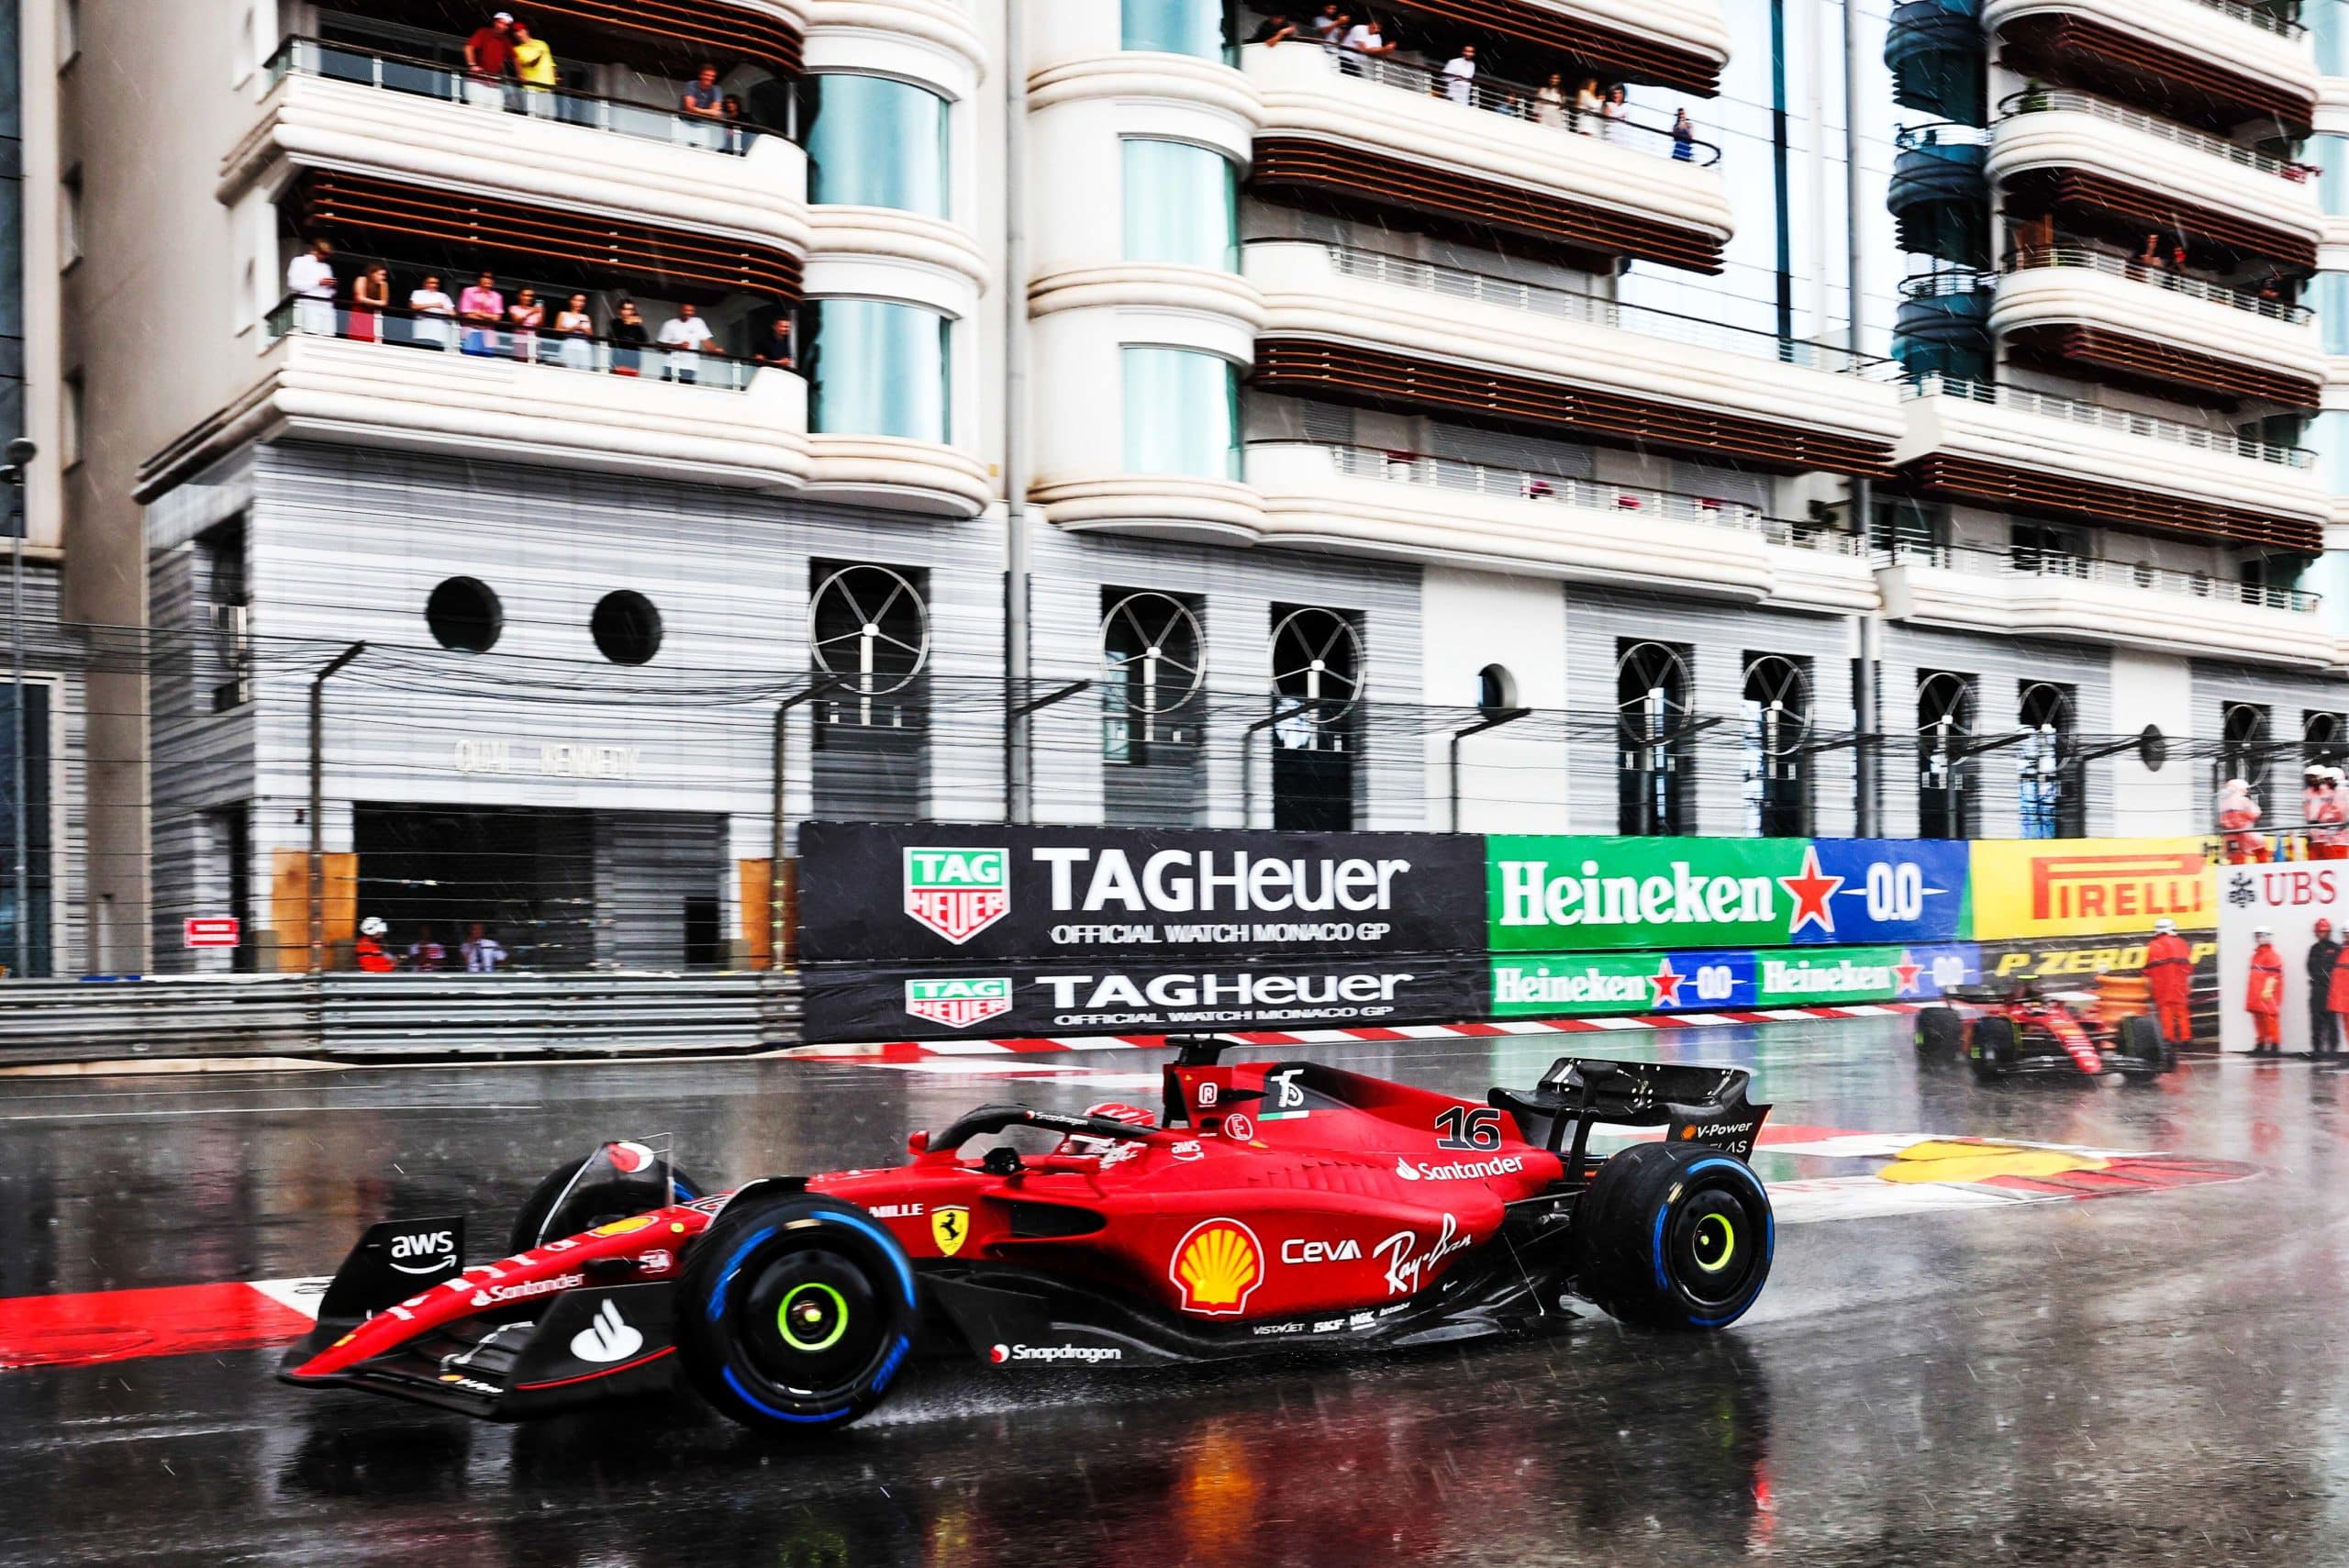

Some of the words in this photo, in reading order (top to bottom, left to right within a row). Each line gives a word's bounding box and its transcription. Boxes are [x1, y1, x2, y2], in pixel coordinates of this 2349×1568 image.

[912, 853, 1000, 883] TAG
[1497, 860, 1776, 926] Heineken
[2031, 853, 2204, 919] PIRELLI
[2261, 870, 2336, 906] UBS
[912, 892, 1004, 936] HEUER
[1051, 923, 1163, 944] OFFICIAL
[1164, 923, 1249, 943] WATCH
[1252, 922, 1354, 942] MONACO
[1356, 922, 1390, 941] GP
[1994, 953, 2032, 977] P
[2034, 945, 2150, 975] ZERO
[914, 981, 1003, 997] TAG
[1494, 967, 1648, 1003] Heineken
[1761, 960, 1893, 994] Heineken
[913, 1001, 1006, 1025] HEUER
[1053, 1012, 1165, 1026] OFFICIAL
[1168, 1010, 1252, 1023] WATCH
[1256, 1006, 1358, 1020] MONACO
[1360, 1006, 1395, 1018] GP
[1434, 1105, 1502, 1152] 16
[1697, 1122, 1753, 1139] V-Power
[1171, 1140, 1201, 1154] aws
[1418, 1156, 1524, 1181] Santander
[391, 1230, 454, 1259] aws
[1011, 1343, 1122, 1363] Snapdragon
